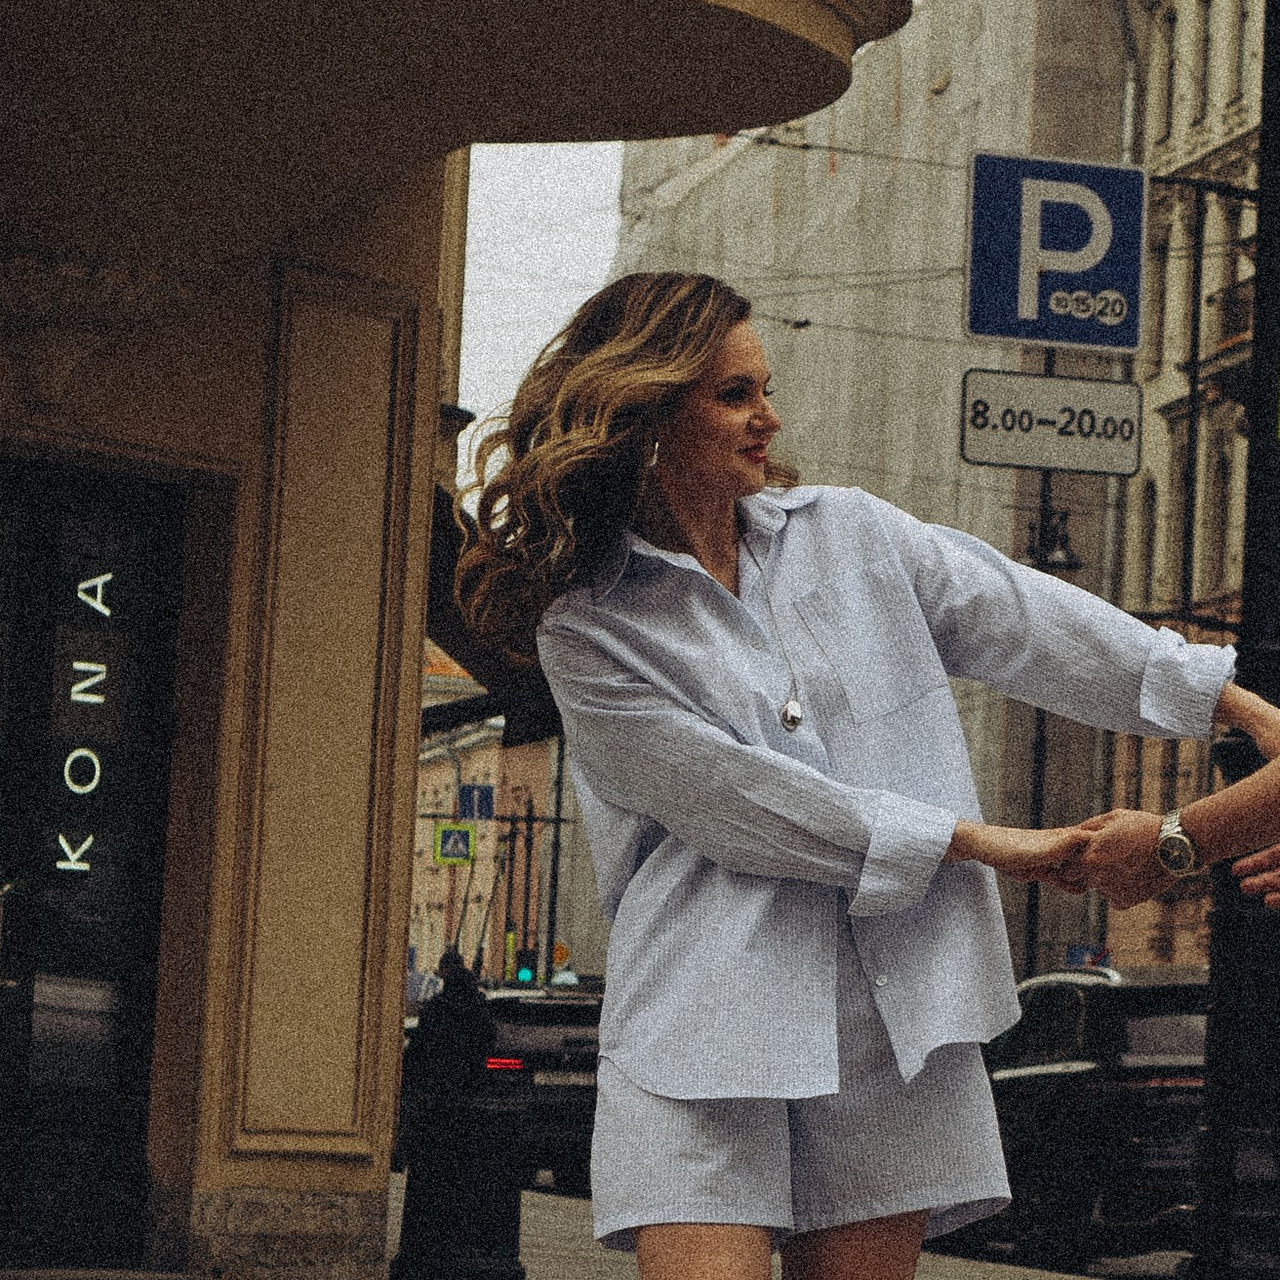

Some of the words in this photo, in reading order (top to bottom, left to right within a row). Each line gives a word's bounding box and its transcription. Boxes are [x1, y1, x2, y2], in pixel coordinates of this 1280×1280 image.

[1017, 177, 1113, 321] P
[1098, 296, 1124, 318] 20
[56, 572, 114, 872] KONA
